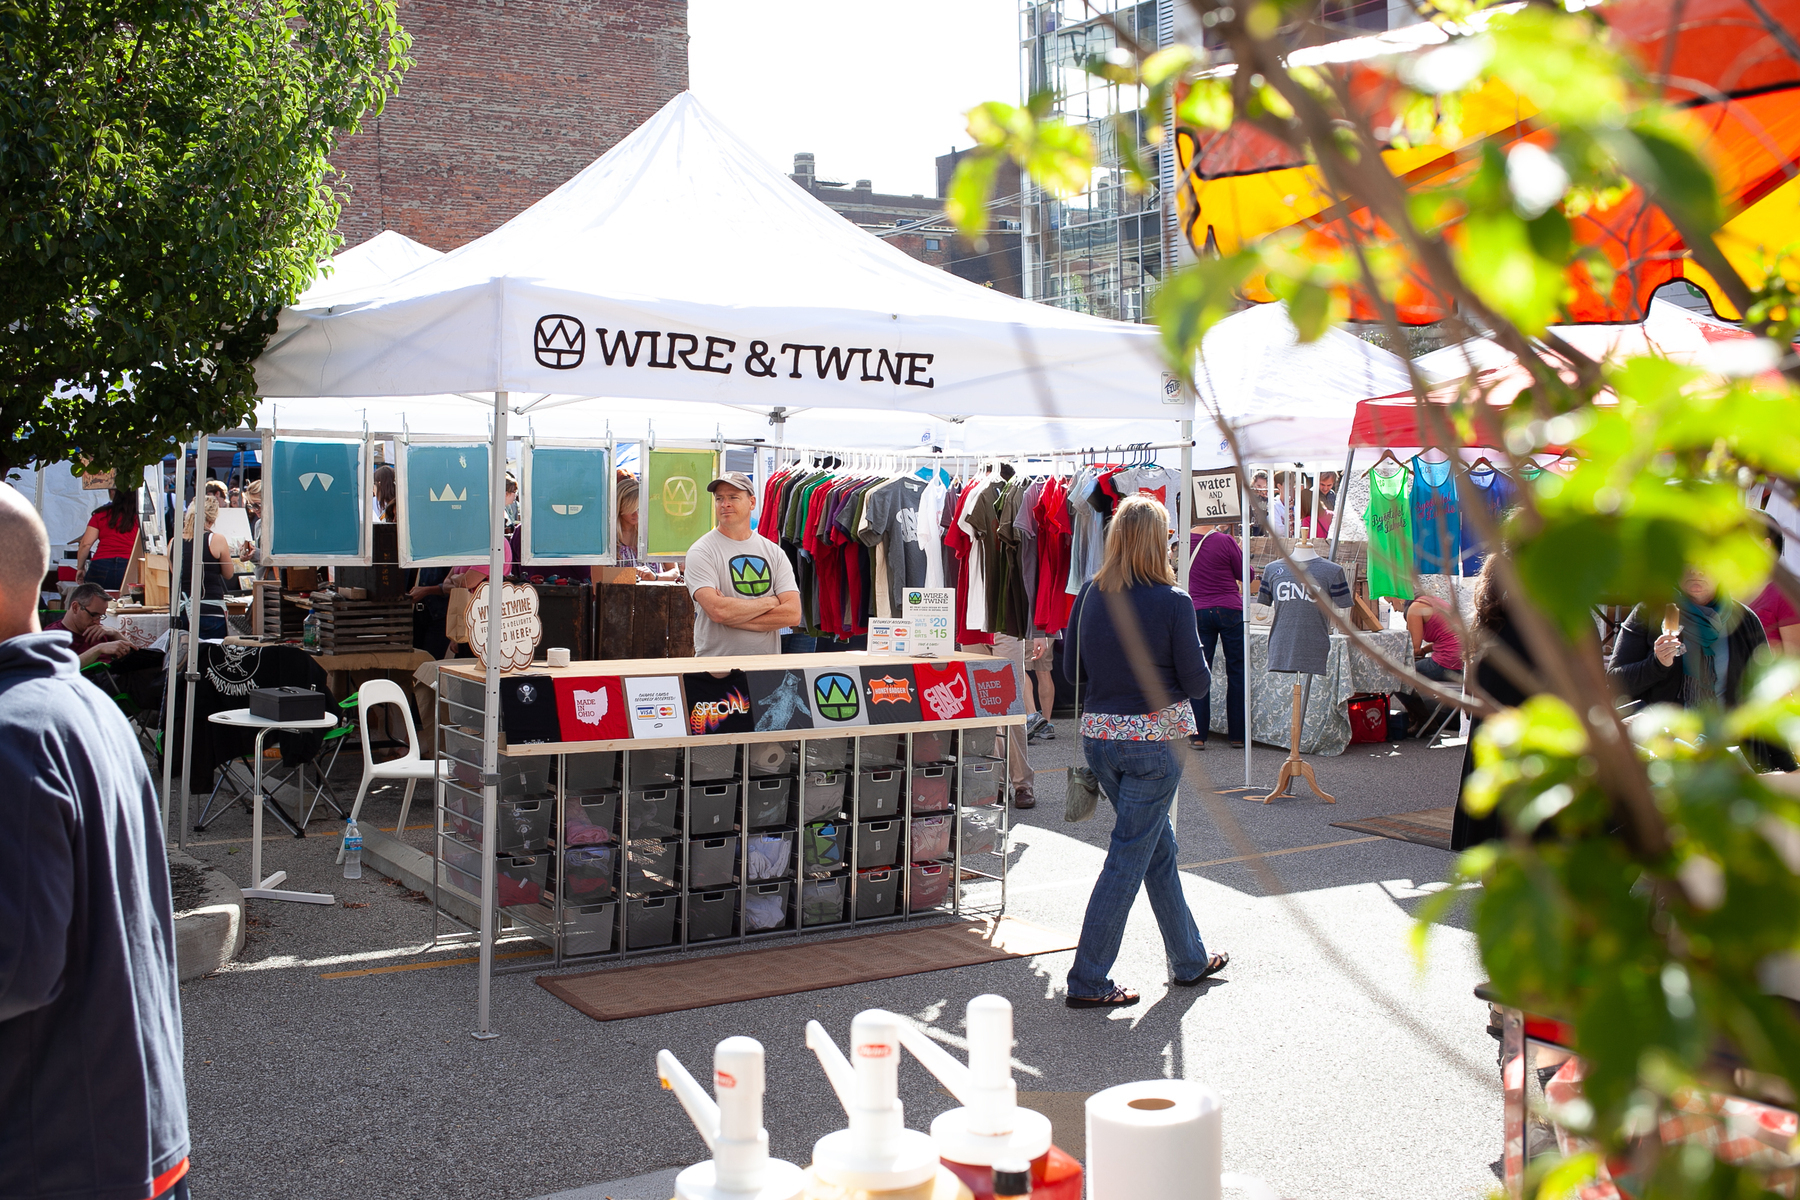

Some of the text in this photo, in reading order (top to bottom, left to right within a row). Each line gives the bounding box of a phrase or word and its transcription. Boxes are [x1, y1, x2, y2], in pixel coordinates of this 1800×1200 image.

[596, 327, 935, 389] WIRE & TWINE
[1197, 478, 1231, 490] water
[1209, 490, 1223, 499] AND
[1206, 499, 1228, 516] salt
[930, 617, 948, 628] $20
[510, 626, 530, 640] HERE
[930, 628, 947, 639] $15
[977, 680, 1001, 690] MADE
[979, 690, 988, 698] IN
[980, 697, 1002, 706] OHIO
[696, 700, 748, 716] SPECIAL
